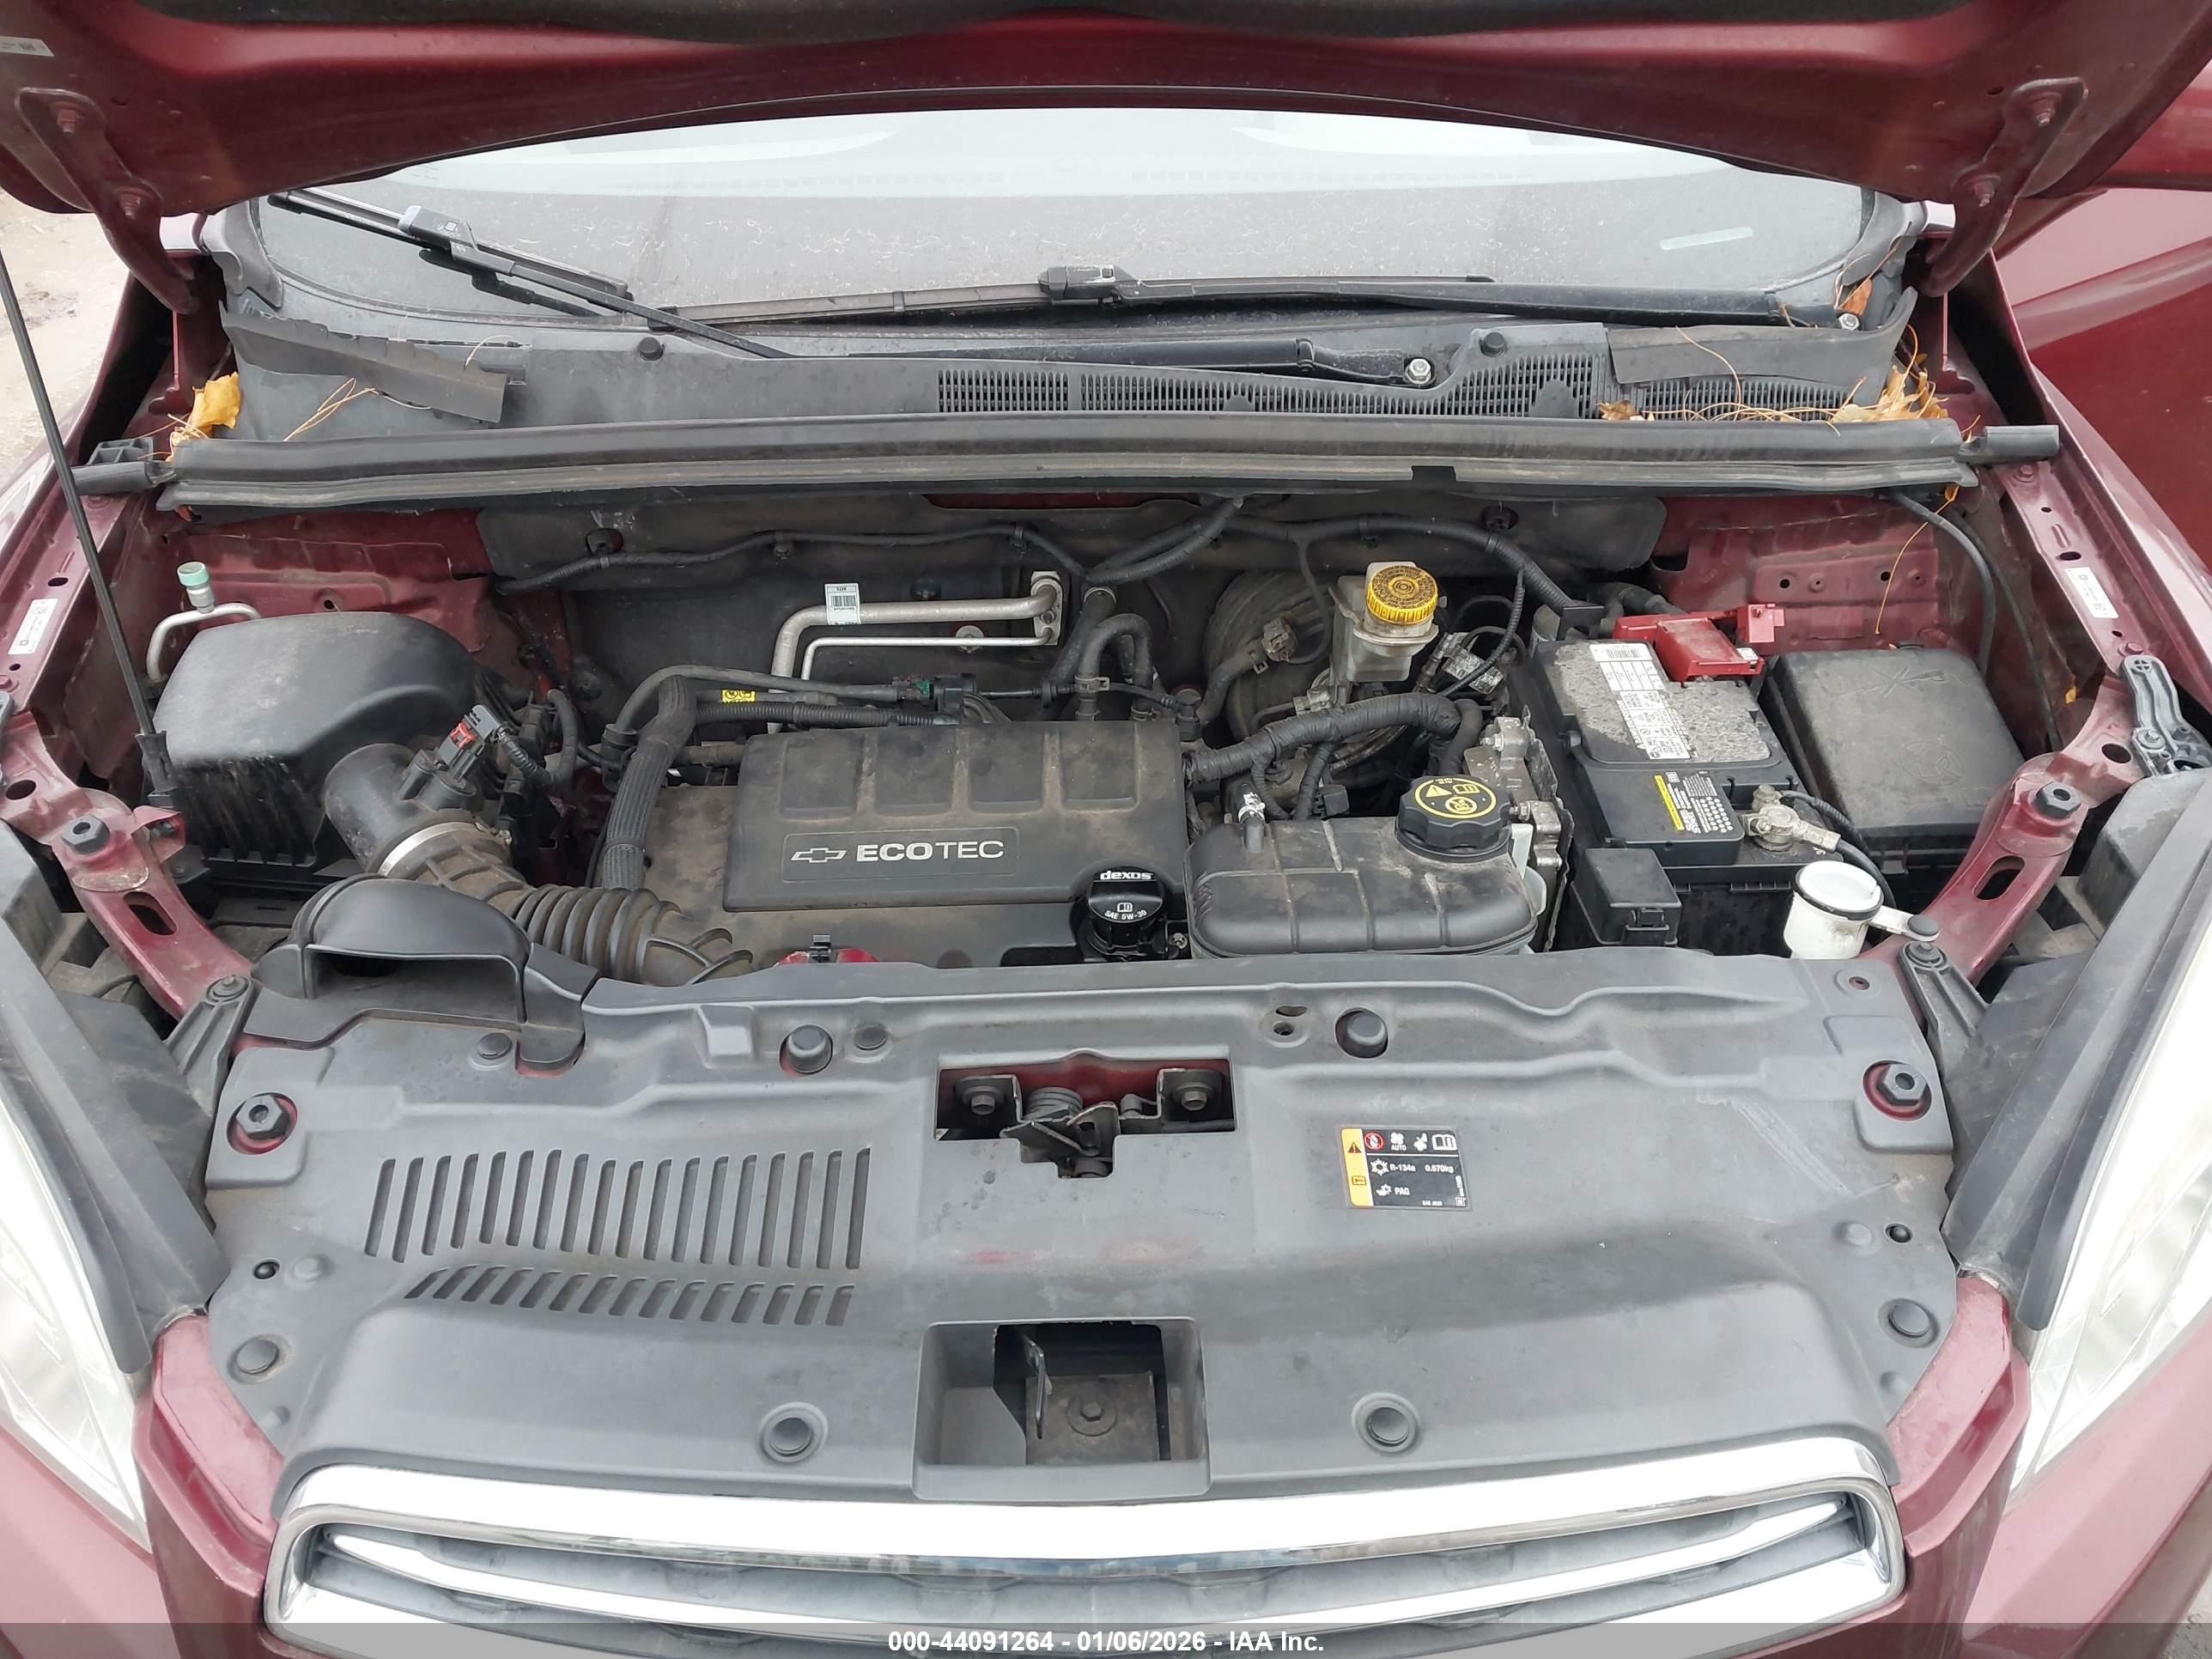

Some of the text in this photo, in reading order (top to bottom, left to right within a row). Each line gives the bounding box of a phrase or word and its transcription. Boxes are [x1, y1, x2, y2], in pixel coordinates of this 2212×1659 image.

[856, 841, 1004, 862] ECOTEC
[1100, 870, 1152, 880] dexos
[1104, 909, 1147, 921] SAE 5W-30
